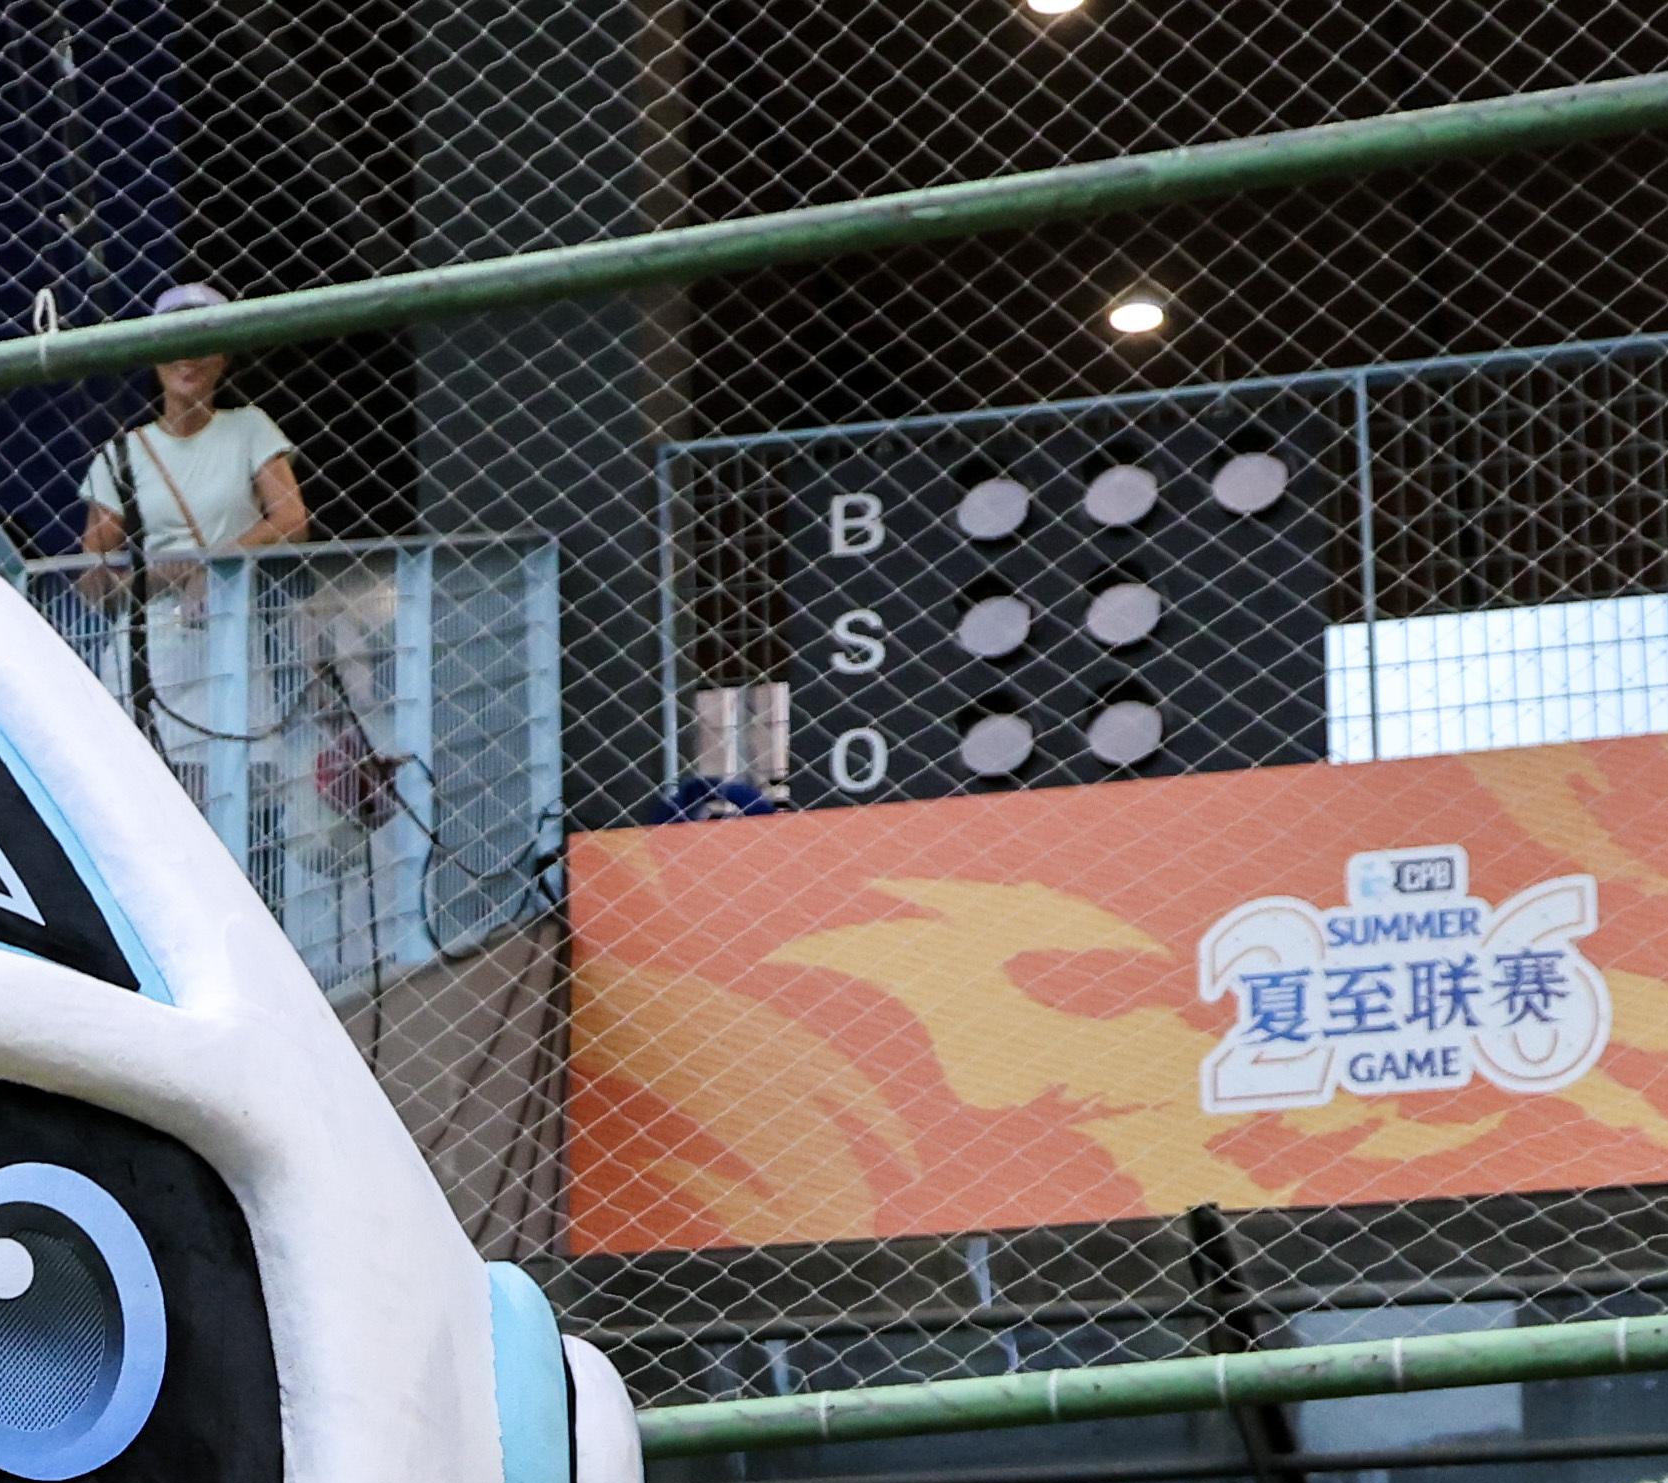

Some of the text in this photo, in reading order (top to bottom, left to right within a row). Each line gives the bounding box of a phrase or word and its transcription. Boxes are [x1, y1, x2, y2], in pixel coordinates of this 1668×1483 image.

[830, 492, 887, 557] B
[830, 608, 887, 675] S
[1326, 906, 1481, 948] SUMMER
[1238, 947, 1569, 1046] 夏至联赛
[1348, 1046, 1461, 1084] GAME
